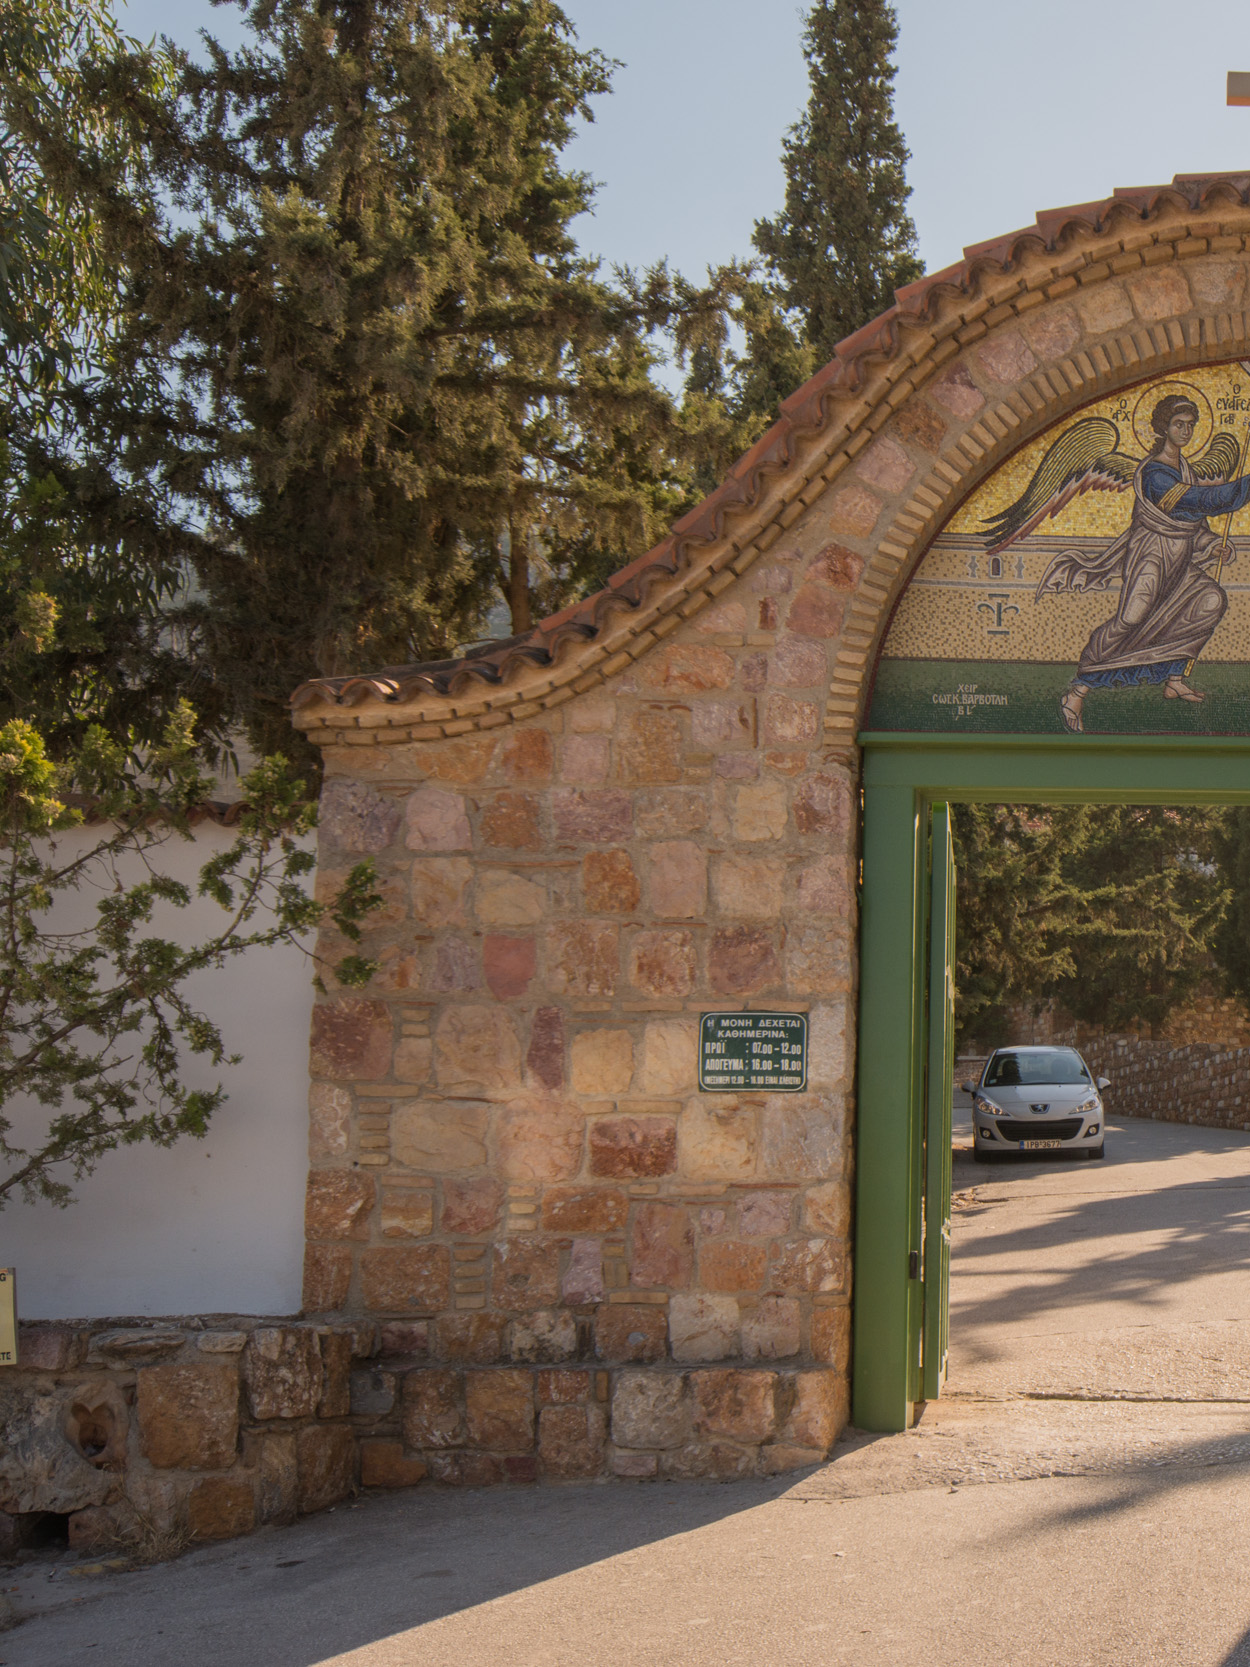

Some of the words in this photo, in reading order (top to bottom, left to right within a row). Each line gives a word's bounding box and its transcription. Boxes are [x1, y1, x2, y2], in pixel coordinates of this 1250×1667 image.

[707, 1019, 715, 1028] Η
[721, 1019, 753, 1028] ΜΟΝΗ
[758, 1019, 801, 1028] ΔΕΧΕΤΑΙ
[752, 1042, 773, 1054] 07.00
[781, 1042, 802, 1055] 12.00
[752, 1059, 773, 1071] 16.00
[780, 1059, 802, 1071] 18.00
